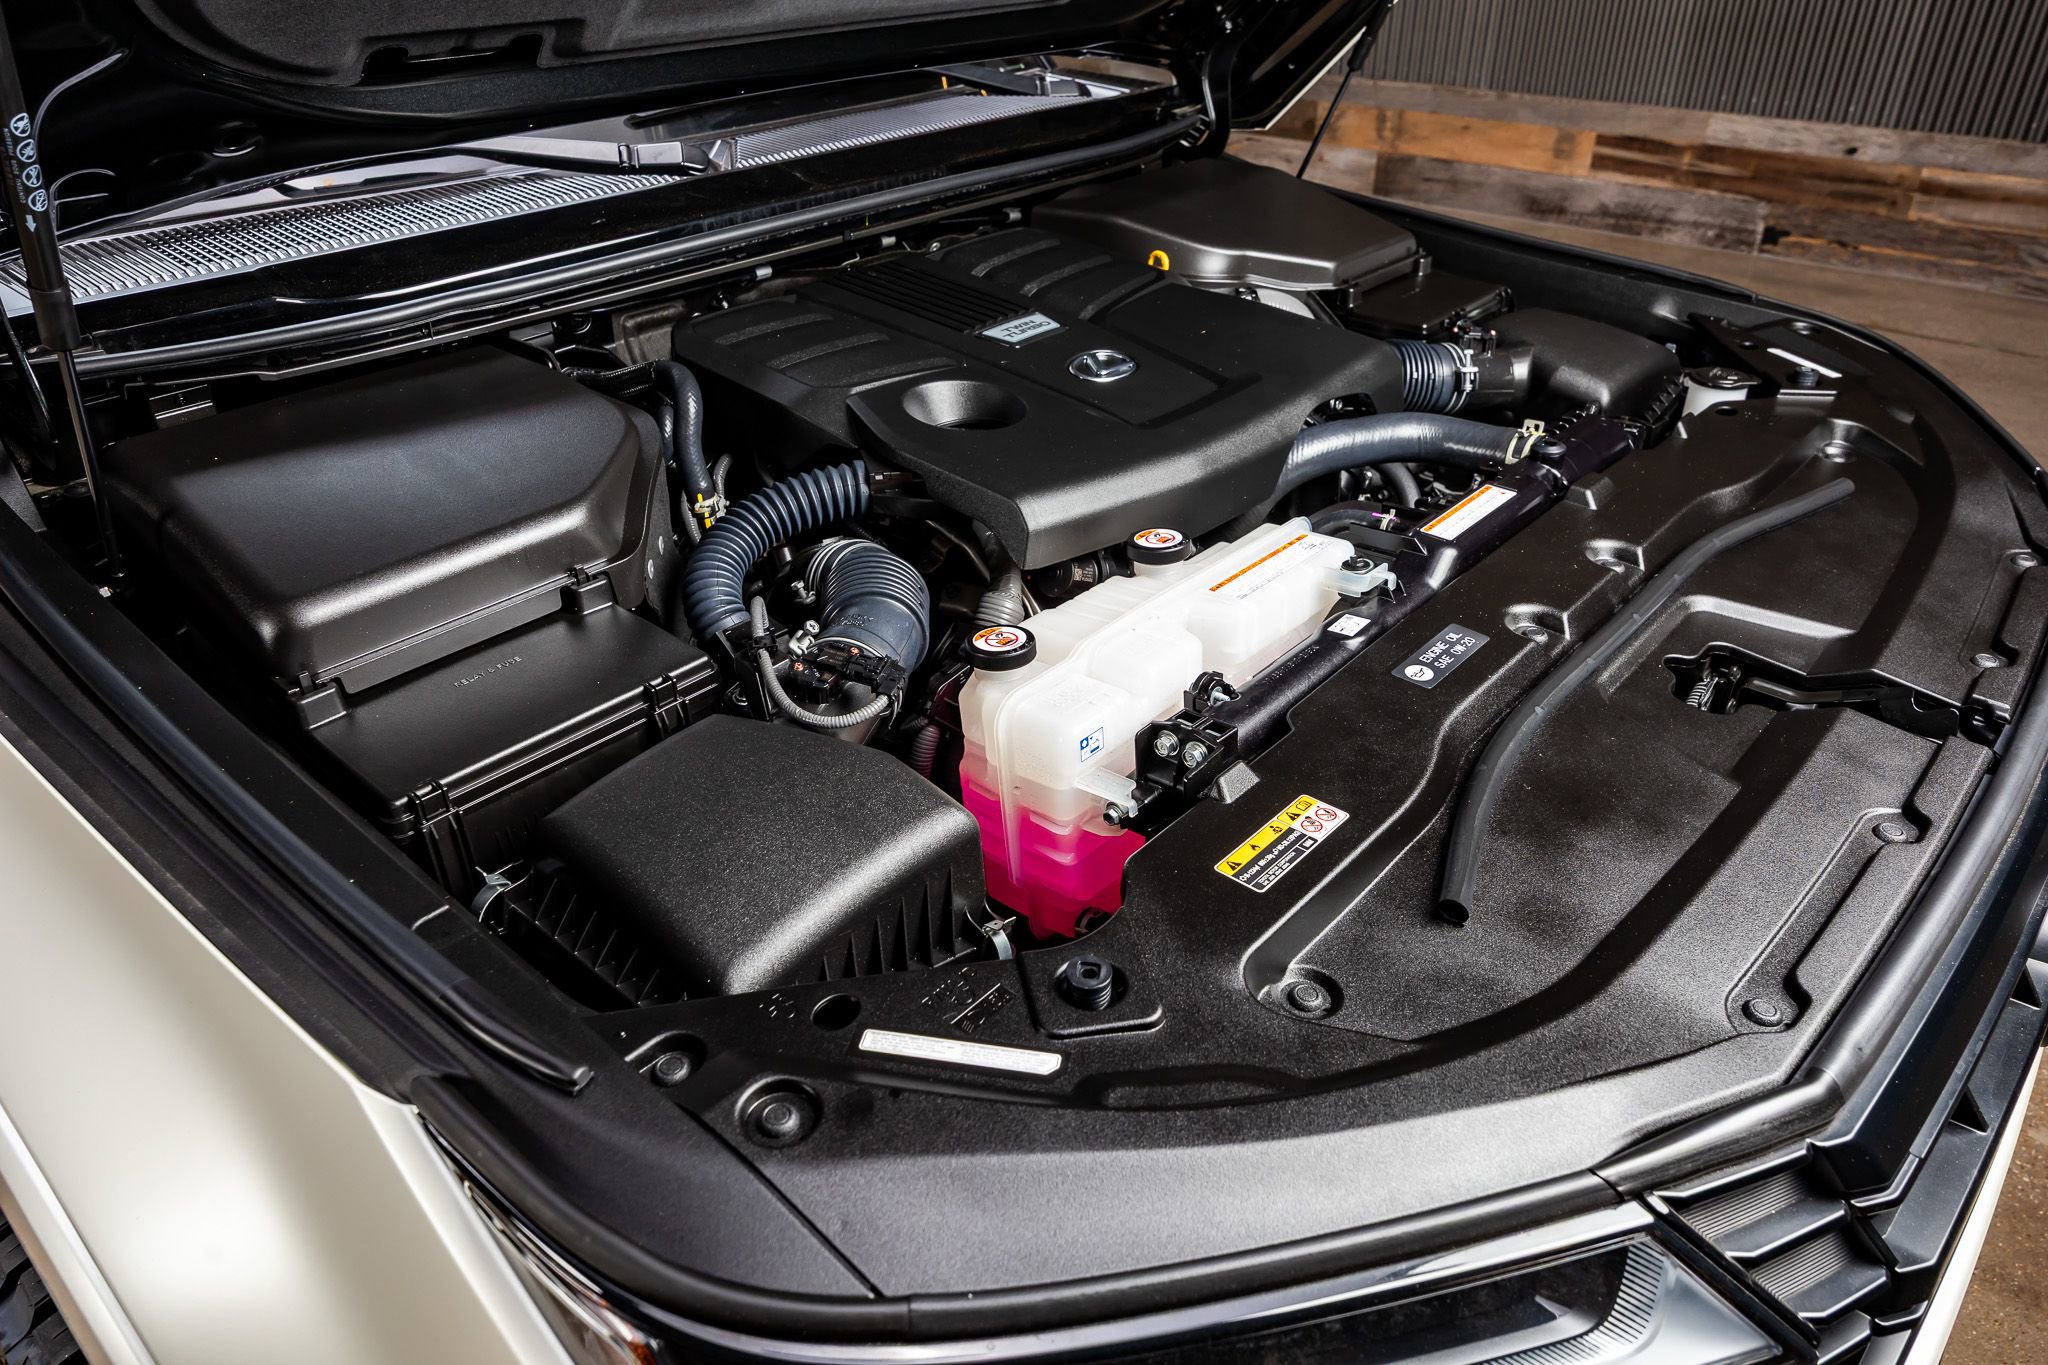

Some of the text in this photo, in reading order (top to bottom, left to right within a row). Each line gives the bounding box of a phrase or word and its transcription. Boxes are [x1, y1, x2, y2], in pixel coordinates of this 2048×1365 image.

[1001, 319, 1037, 333] TWIN
[1002, 320, 1051, 338] TURBO
[1419, 633, 1462, 663] ENGINE OIL
[1434, 636, 1476, 669] SAE 0W-20
[453, 671, 486, 688] RELAY
[495, 656, 522, 669] FUSE
